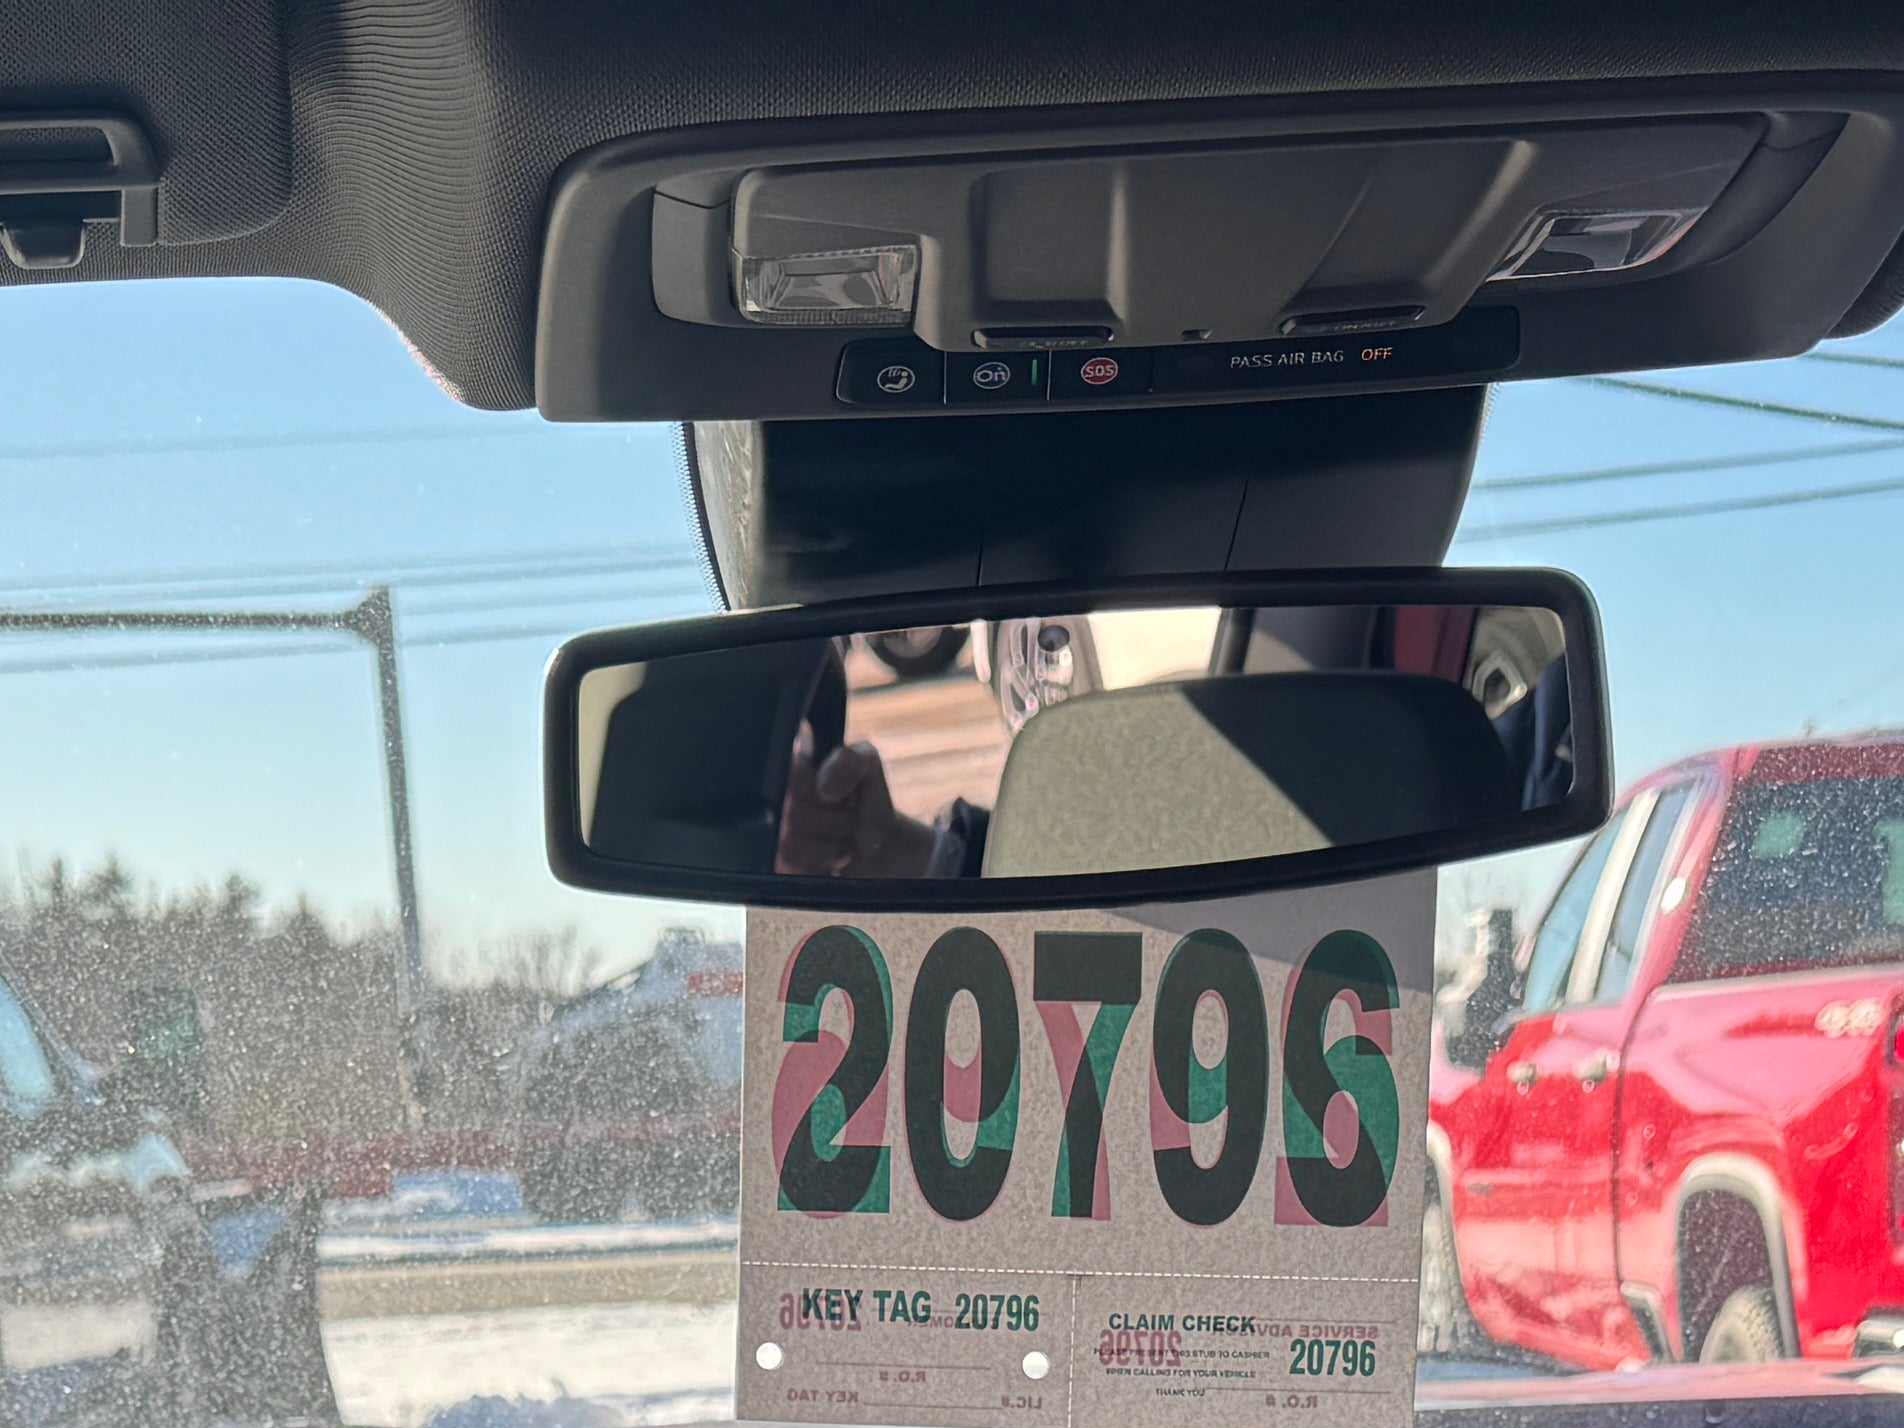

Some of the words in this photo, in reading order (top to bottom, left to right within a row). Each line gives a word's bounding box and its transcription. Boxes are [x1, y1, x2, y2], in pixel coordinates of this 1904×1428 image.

[1085, 363, 1117, 379] SOS
[1230, 354, 1273, 369] PASS
[1278, 351, 1306, 366] AIR
[1312, 350, 1345, 364] BAG
[1361, 347, 1394, 361] OFF
[776, 926, 1400, 1227] 20796
[802, 1287, 864, 1322] KEY
[872, 1289, 932, 1323] TAG
[954, 1291, 1040, 1332] 20796
[1108, 1313, 1175, 1332] CLAIM
[1182, 1315, 1256, 1334] CHECK
[1289, 1338, 1378, 1378] 20796
